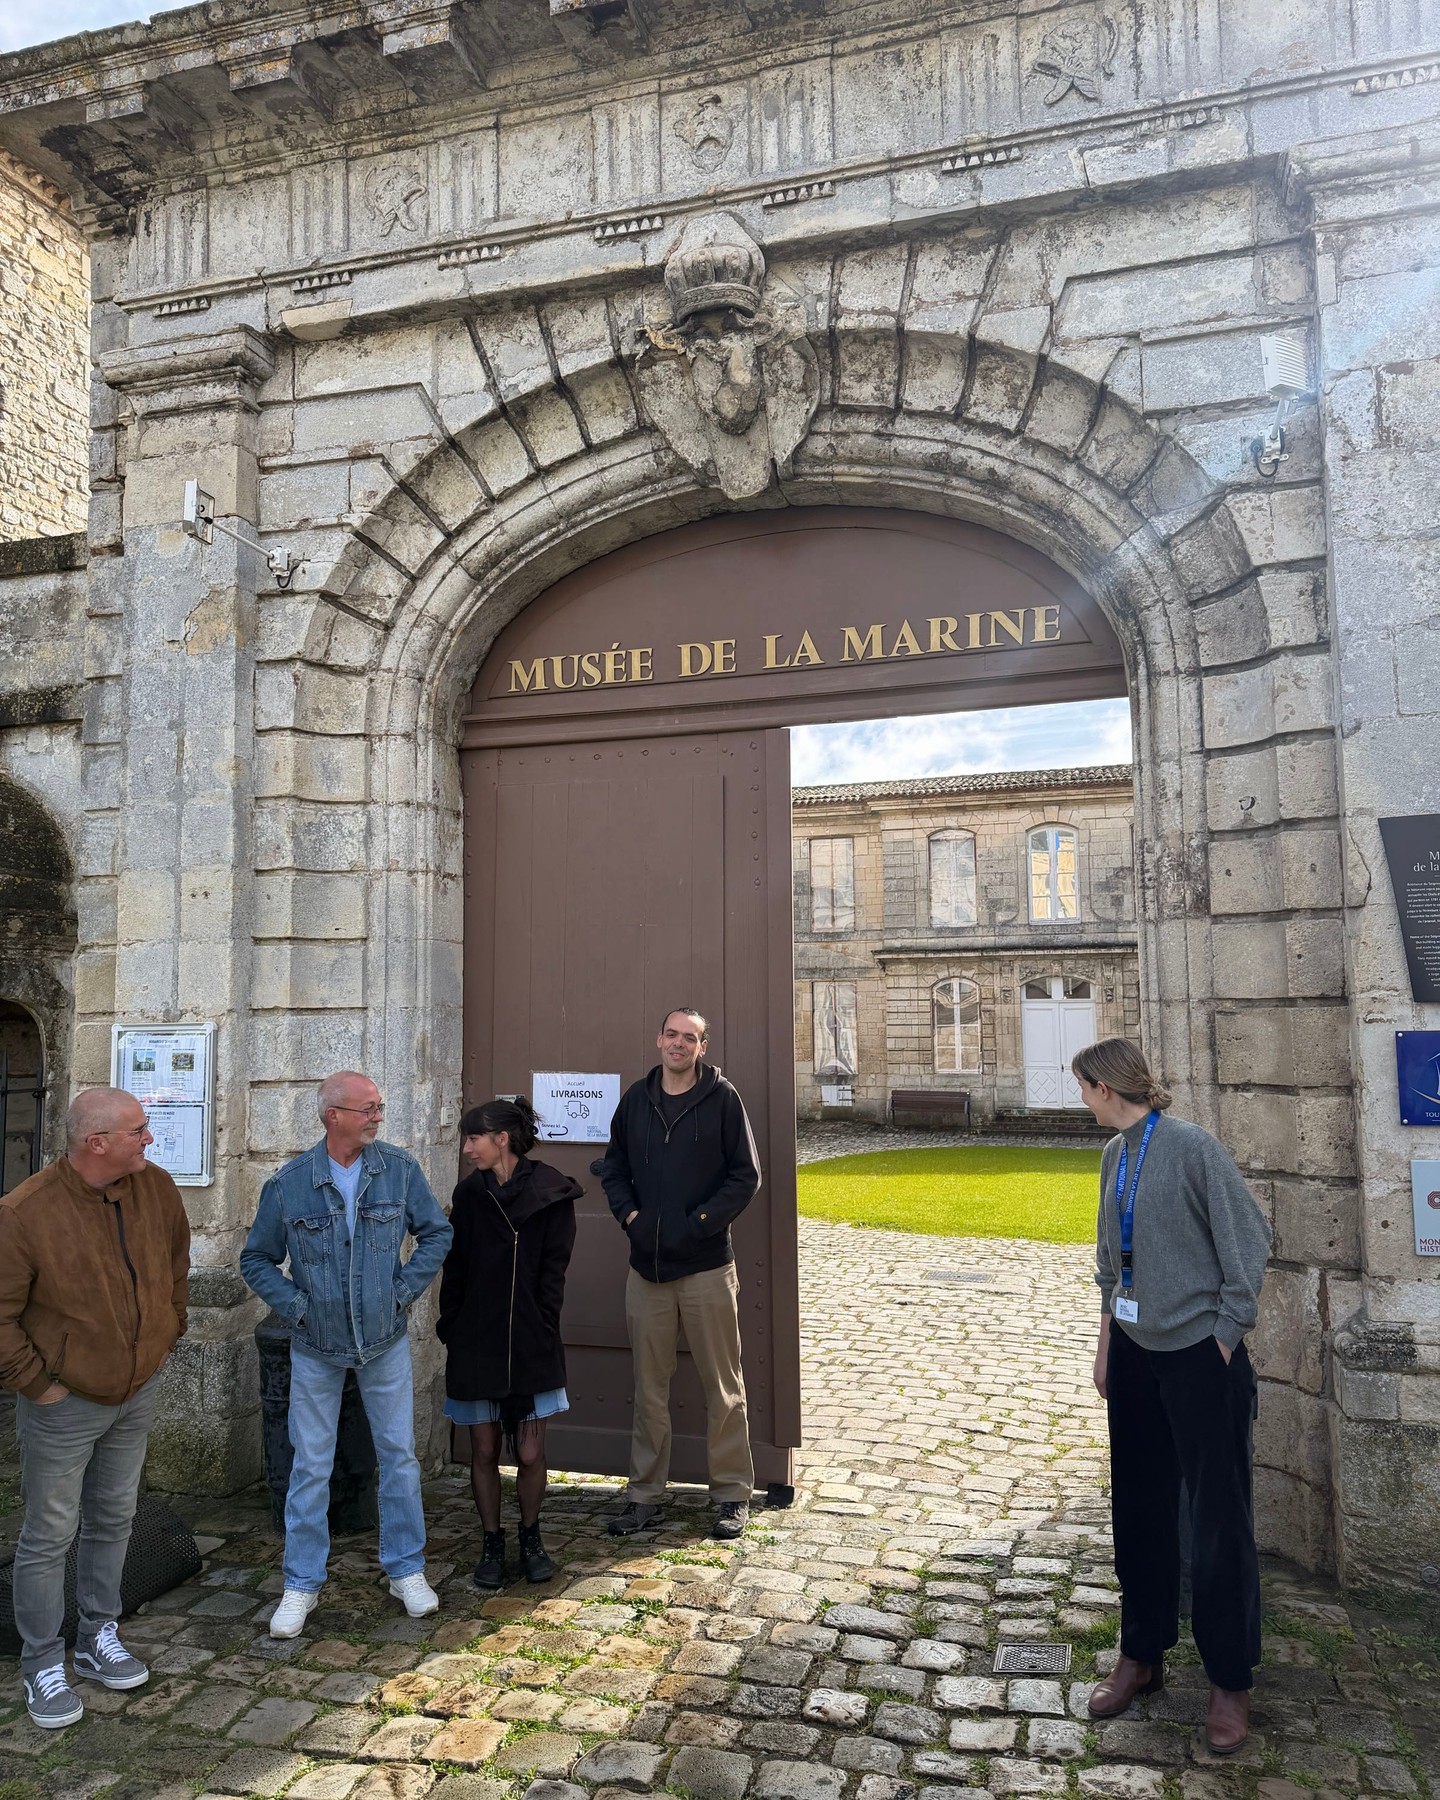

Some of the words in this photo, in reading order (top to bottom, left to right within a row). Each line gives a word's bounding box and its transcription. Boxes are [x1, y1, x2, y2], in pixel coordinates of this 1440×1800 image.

[507, 643, 655, 693] MUSÉE
[678, 638, 738, 678] DE
[763, 629, 825, 670] LA
[840, 604, 1063, 663] MARINE
[1413, 862, 1426, 872] de
[1430, 861, 1440, 872] la
[551, 1090, 603, 1099] LIVRAISONS
[1142, 1123, 1153, 1145] MUSÉE
[1135, 1143, 1147, 1173] NATIONAL
[1126, 1189, 1135, 1213] MARINE
